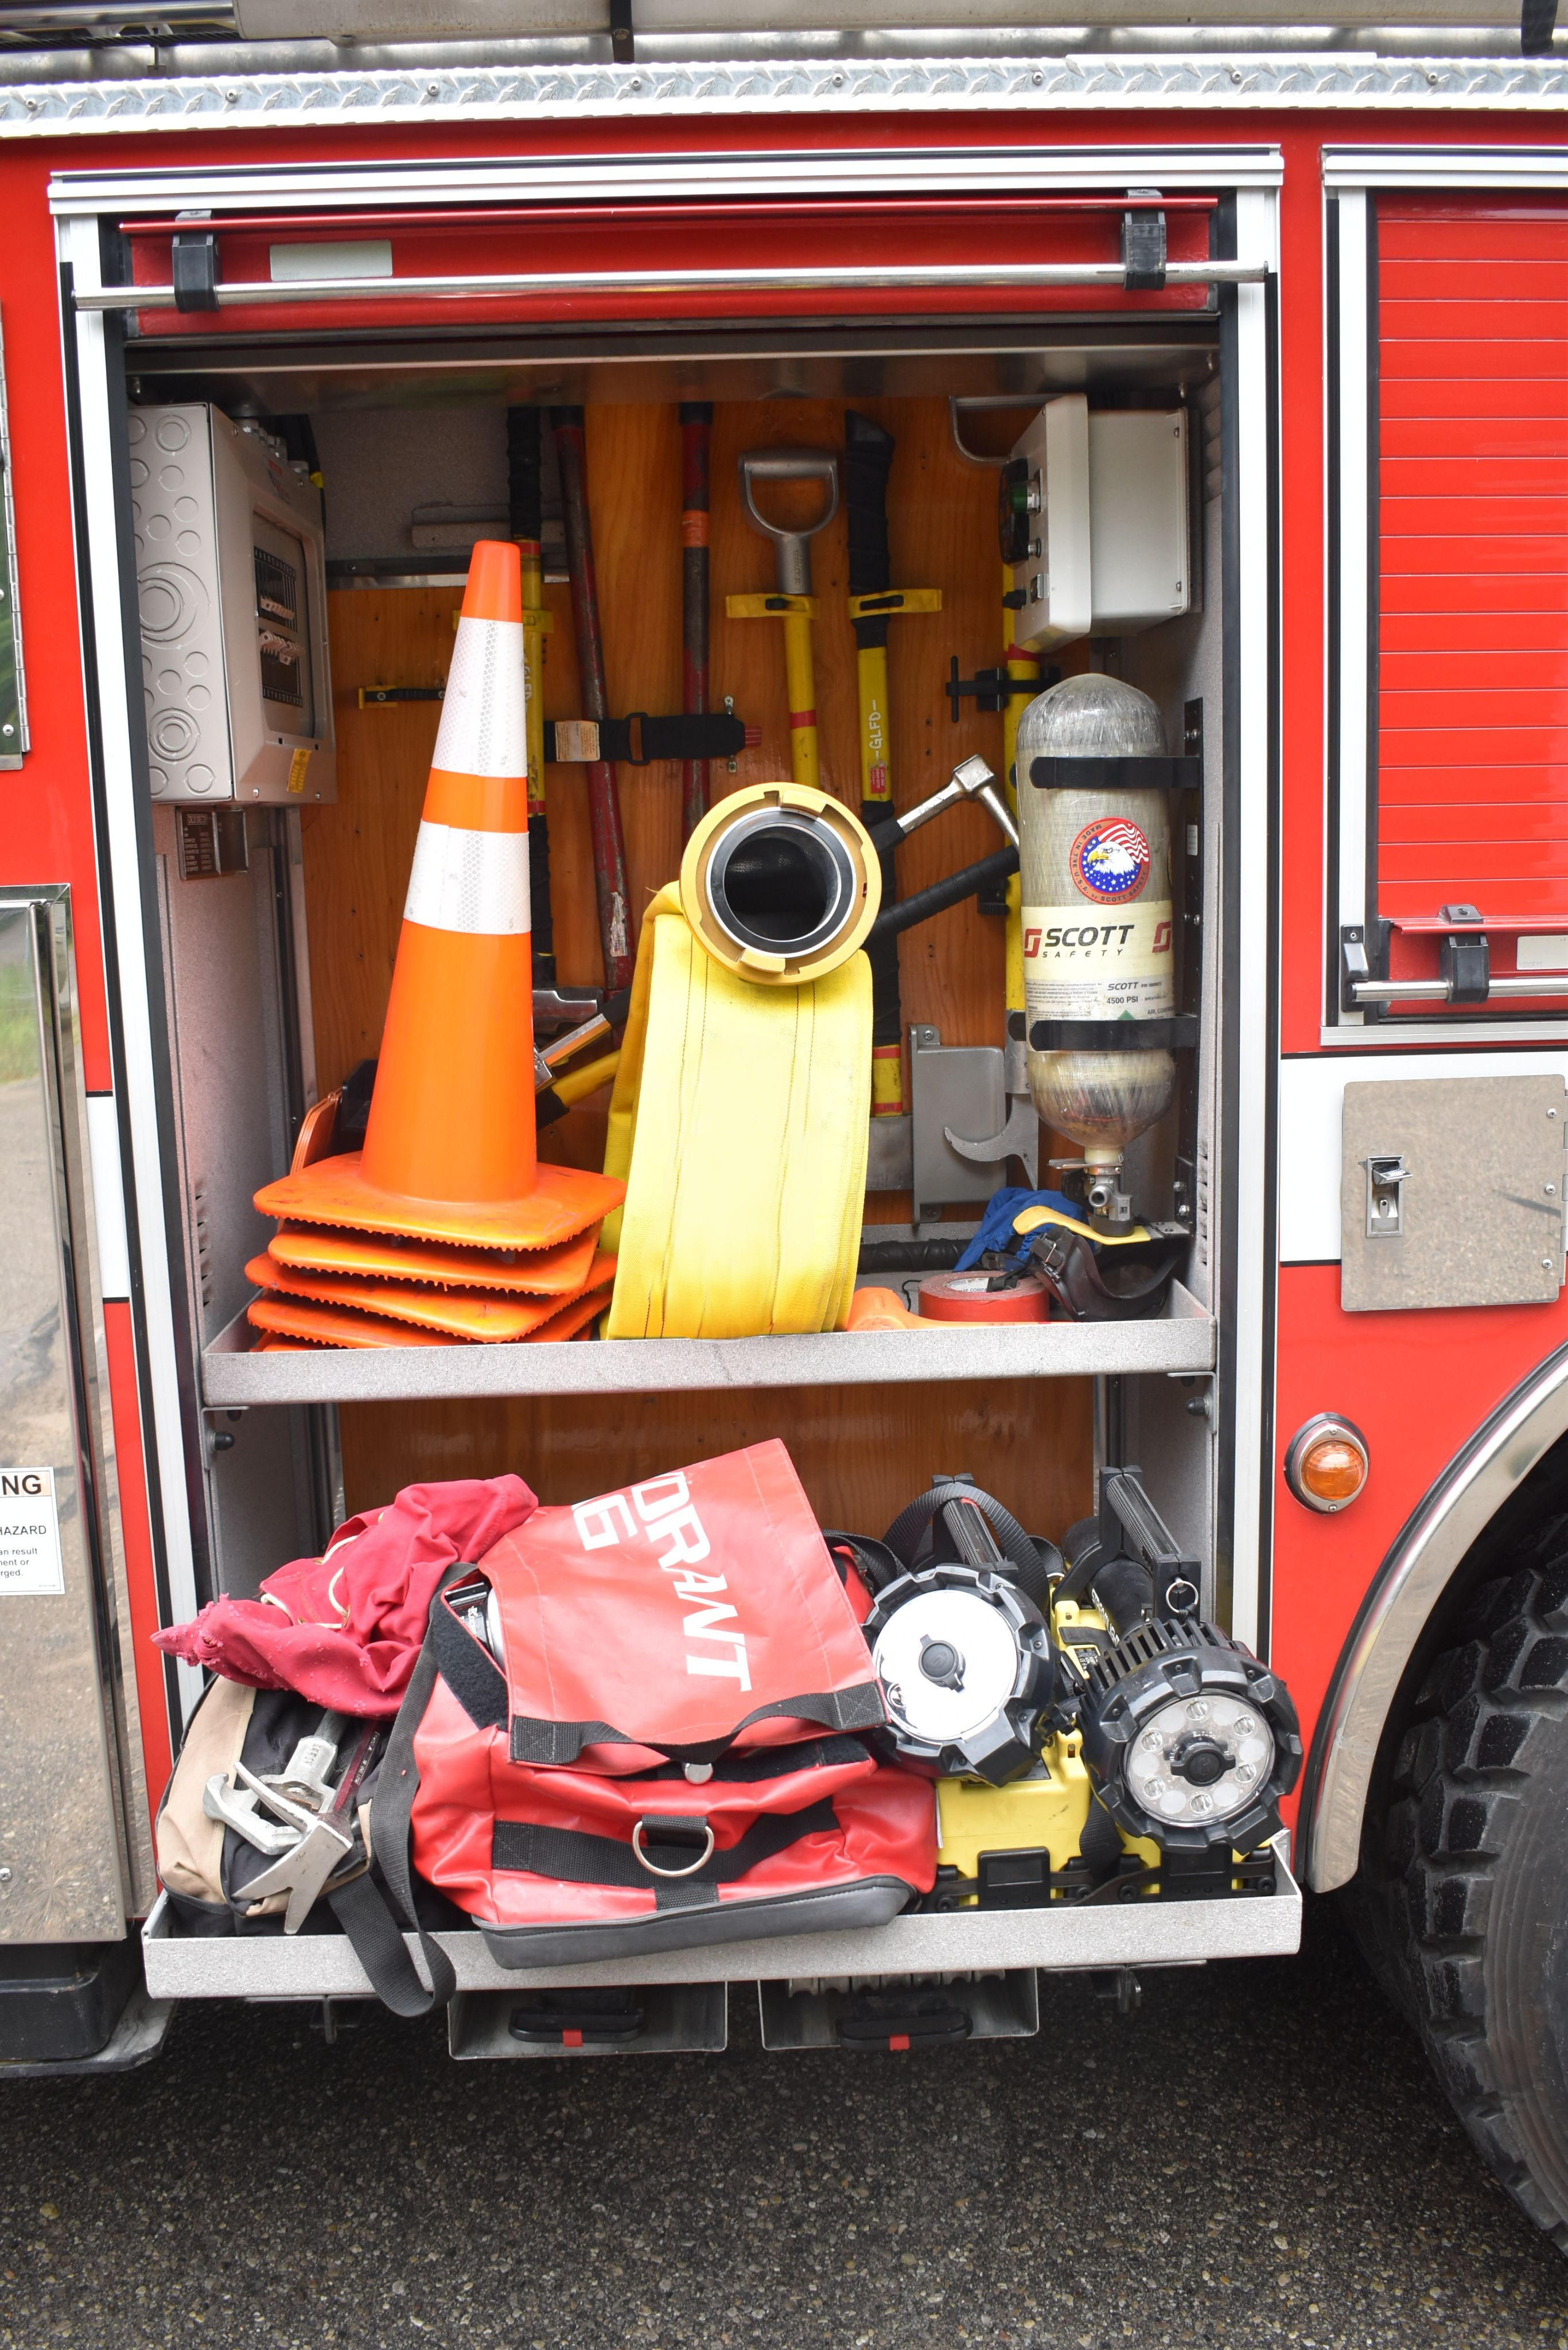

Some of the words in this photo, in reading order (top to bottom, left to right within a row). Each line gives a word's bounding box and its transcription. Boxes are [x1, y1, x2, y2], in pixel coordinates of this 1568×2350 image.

[1082, 824, 1102, 840] MADE
[1076, 842, 1083, 850] IN
[1074, 872, 1088, 893] U.S.A.
[1129, 871, 1146, 895] SAFETY
[1045, 925, 1134, 947] SCOTT
[1042, 948, 1123, 958] SAFETY
[1107, 982, 1139, 991] SCOTT
